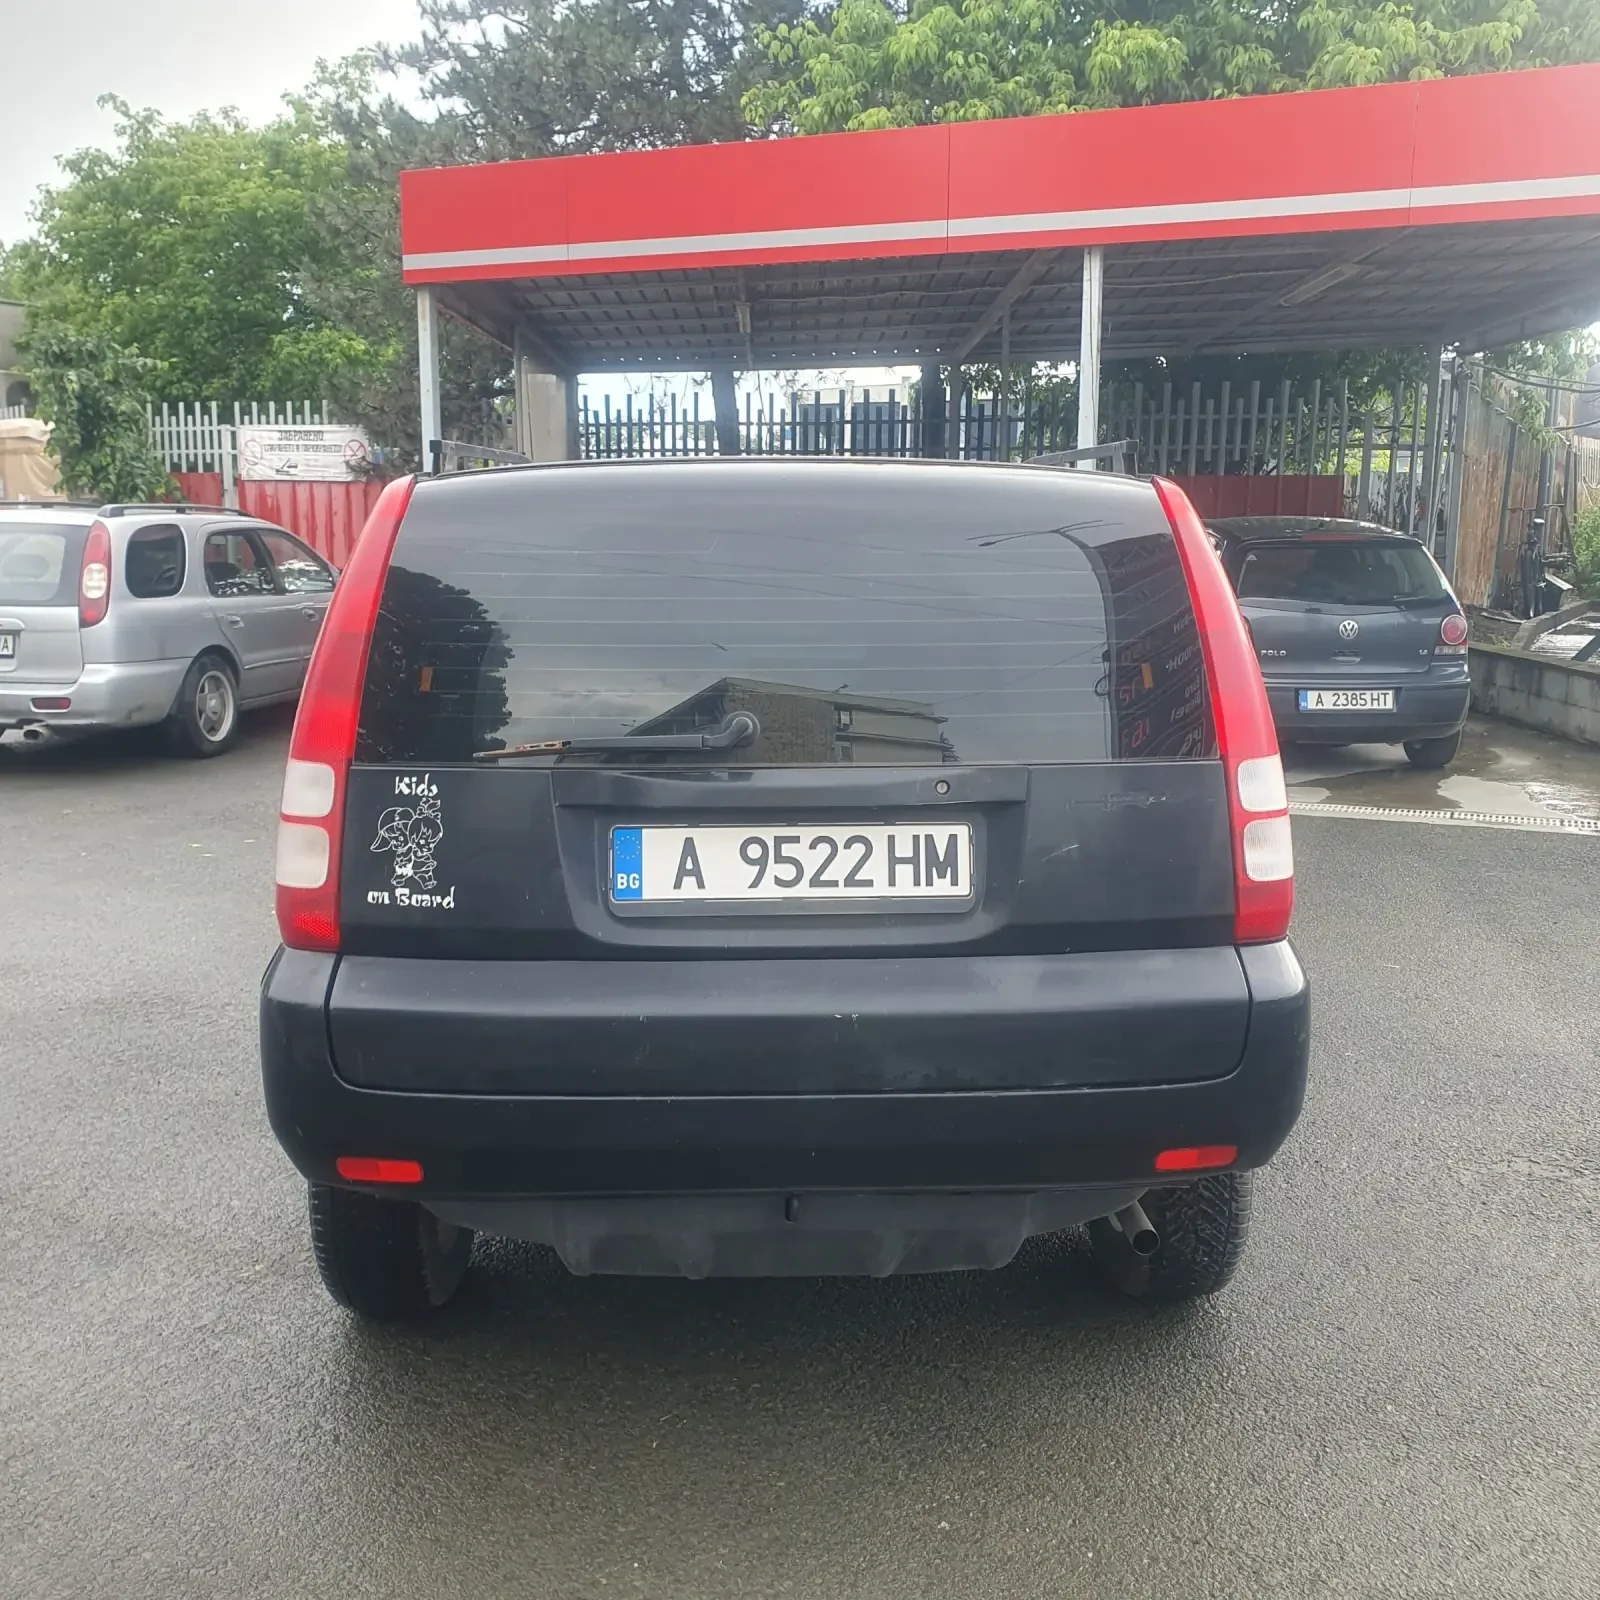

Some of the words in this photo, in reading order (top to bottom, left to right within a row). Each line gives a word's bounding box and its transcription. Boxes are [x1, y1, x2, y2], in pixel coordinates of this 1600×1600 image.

[1315, 692, 1325, 707] A
[394, 773, 439, 797] Kids
[616, 873, 640, 889] BG
[672, 836, 706, 890] A
[366, 891, 391, 905] on
[394, 886, 456, 909] Board
